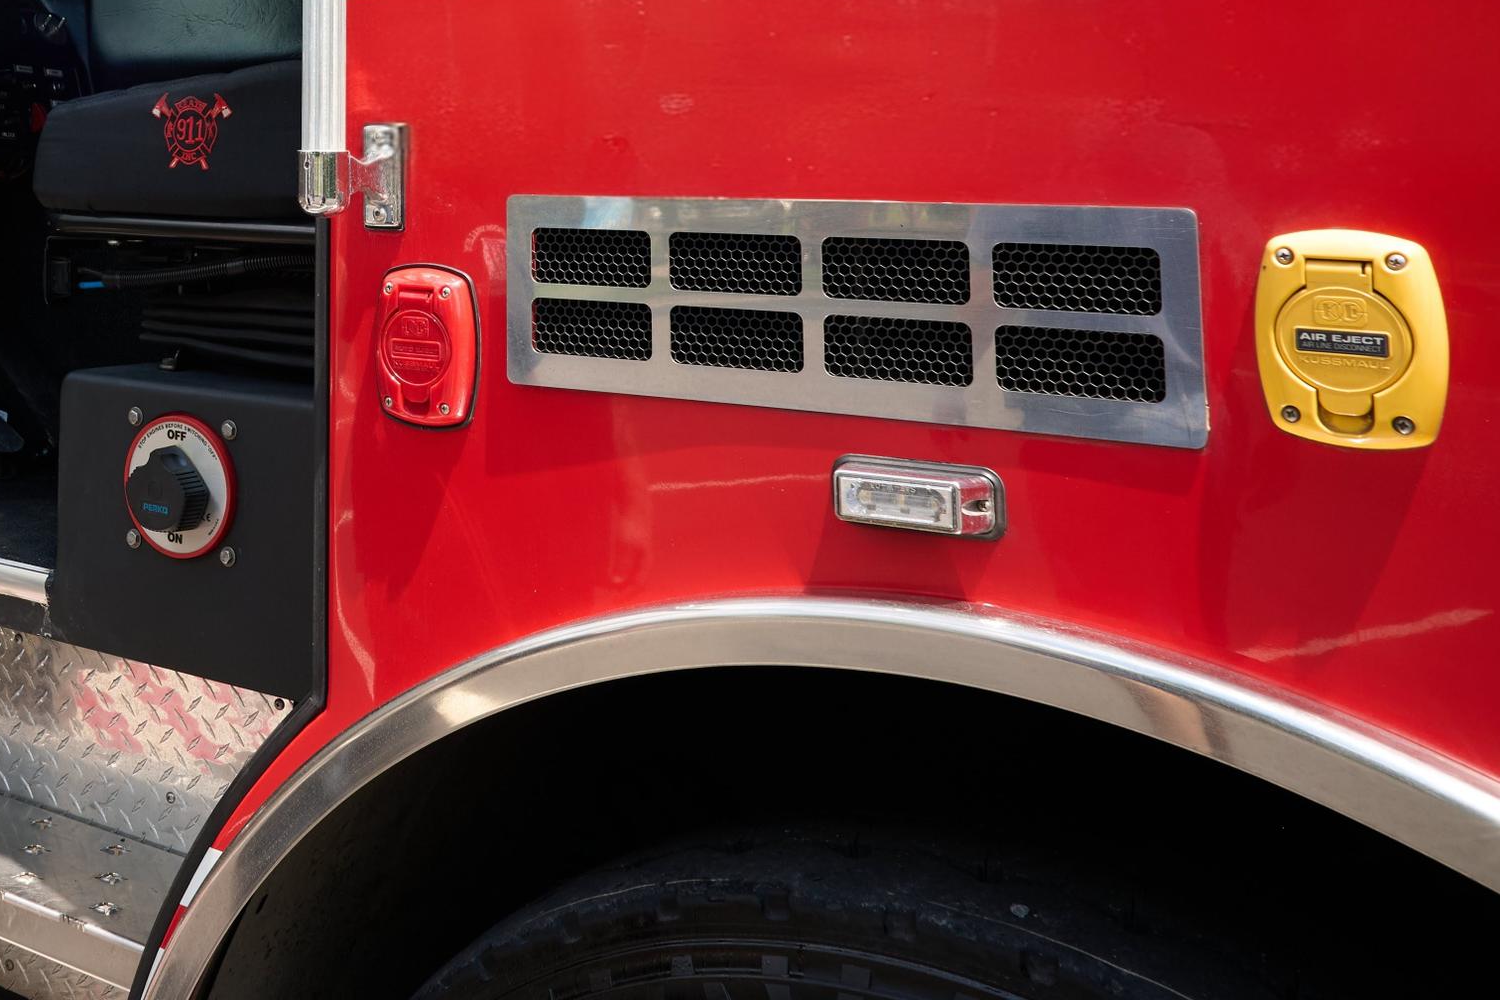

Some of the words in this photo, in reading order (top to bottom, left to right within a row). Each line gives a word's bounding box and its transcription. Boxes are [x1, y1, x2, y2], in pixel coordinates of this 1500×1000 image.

[177, 117, 204, 144] 911
[1299, 332, 1327, 342] AIR
[1331, 334, 1384, 346] EJECT
[1334, 344, 1382, 352] DISCONNECT
[146, 424, 164, 438] ENGINES
[167, 429, 187, 441] OFF
[143, 503, 169, 515] PERKO
[167, 532, 183, 544] ON
